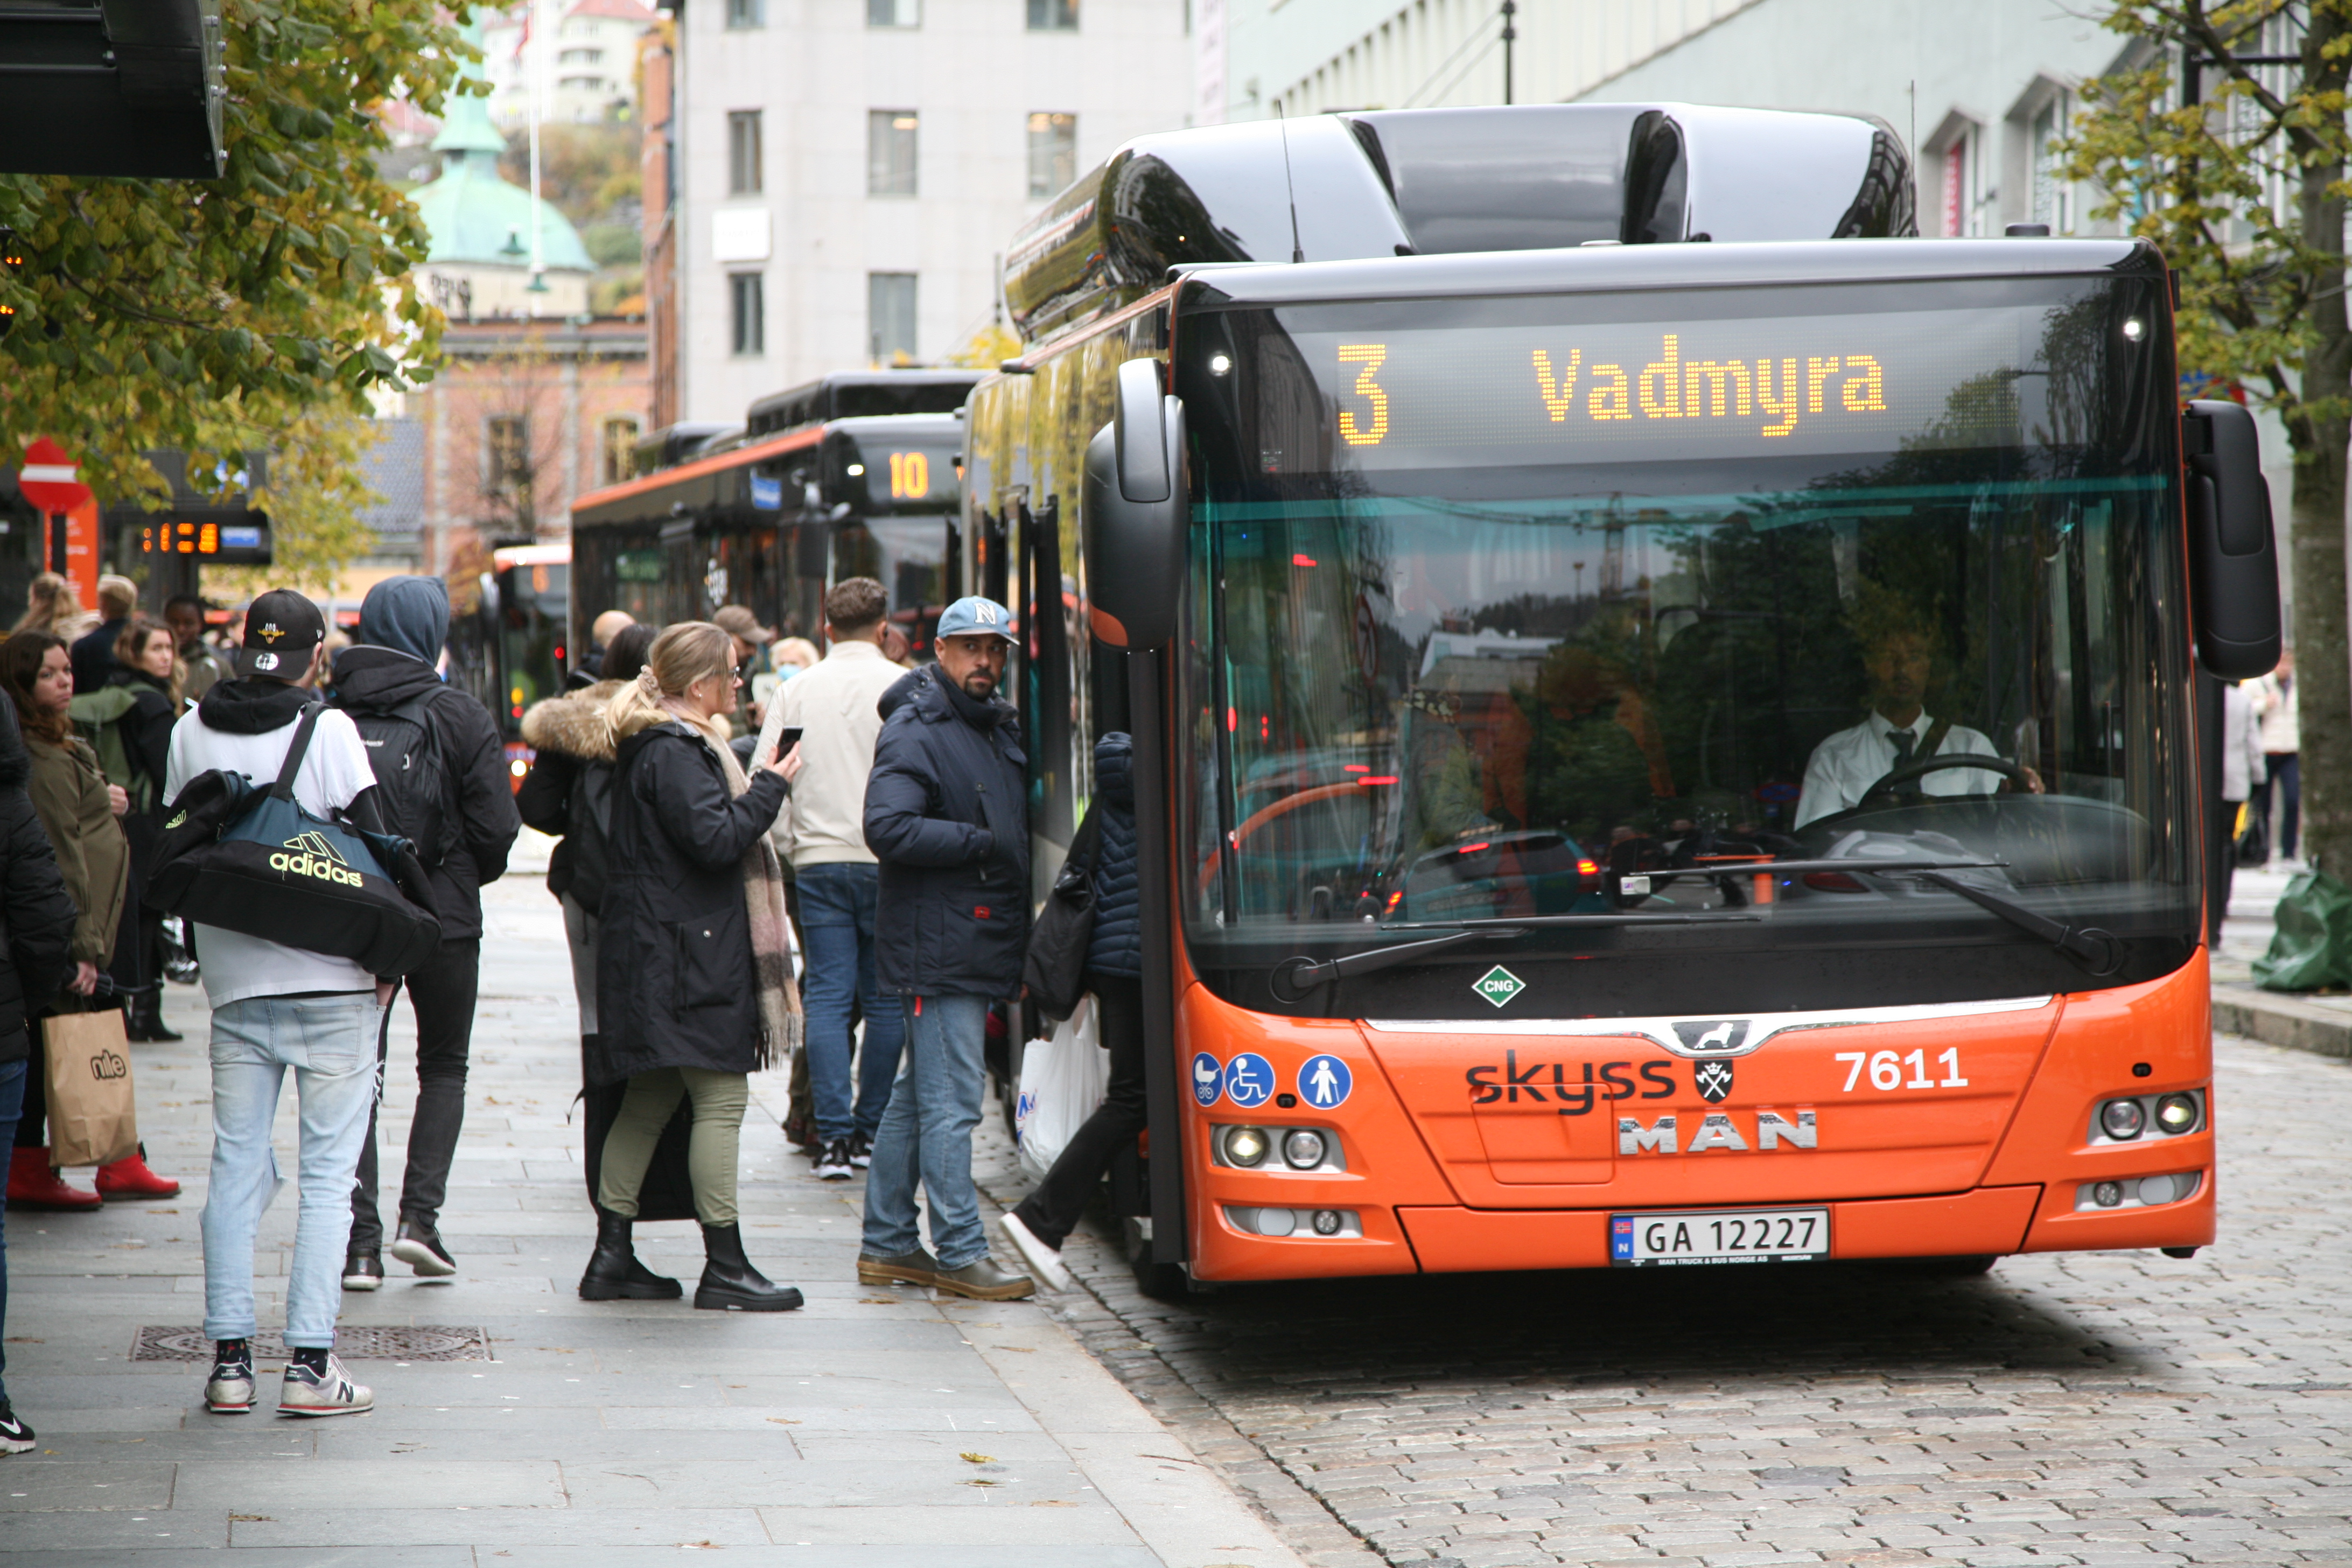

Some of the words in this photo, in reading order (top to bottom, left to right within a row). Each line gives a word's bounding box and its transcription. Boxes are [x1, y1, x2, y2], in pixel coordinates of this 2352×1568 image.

[1338, 344, 1388, 445] 3
[1532, 334, 1886, 437] Vadmyra
[889, 452, 928, 499] 10
[972, 602, 997, 625] N
[269, 852, 363, 888] adidas
[1484, 979, 1514, 992] CNG
[1466, 1049, 1676, 1116] skyss
[1835, 1046, 1969, 1092] 7611
[1618, 1111, 1818, 1155] MAN
[1618, 1243, 1629, 1252] N
[1645, 1222, 1692, 1252] GA
[1710, 1217, 1817, 1251] 12227
[337, 1380, 354, 1403] N
